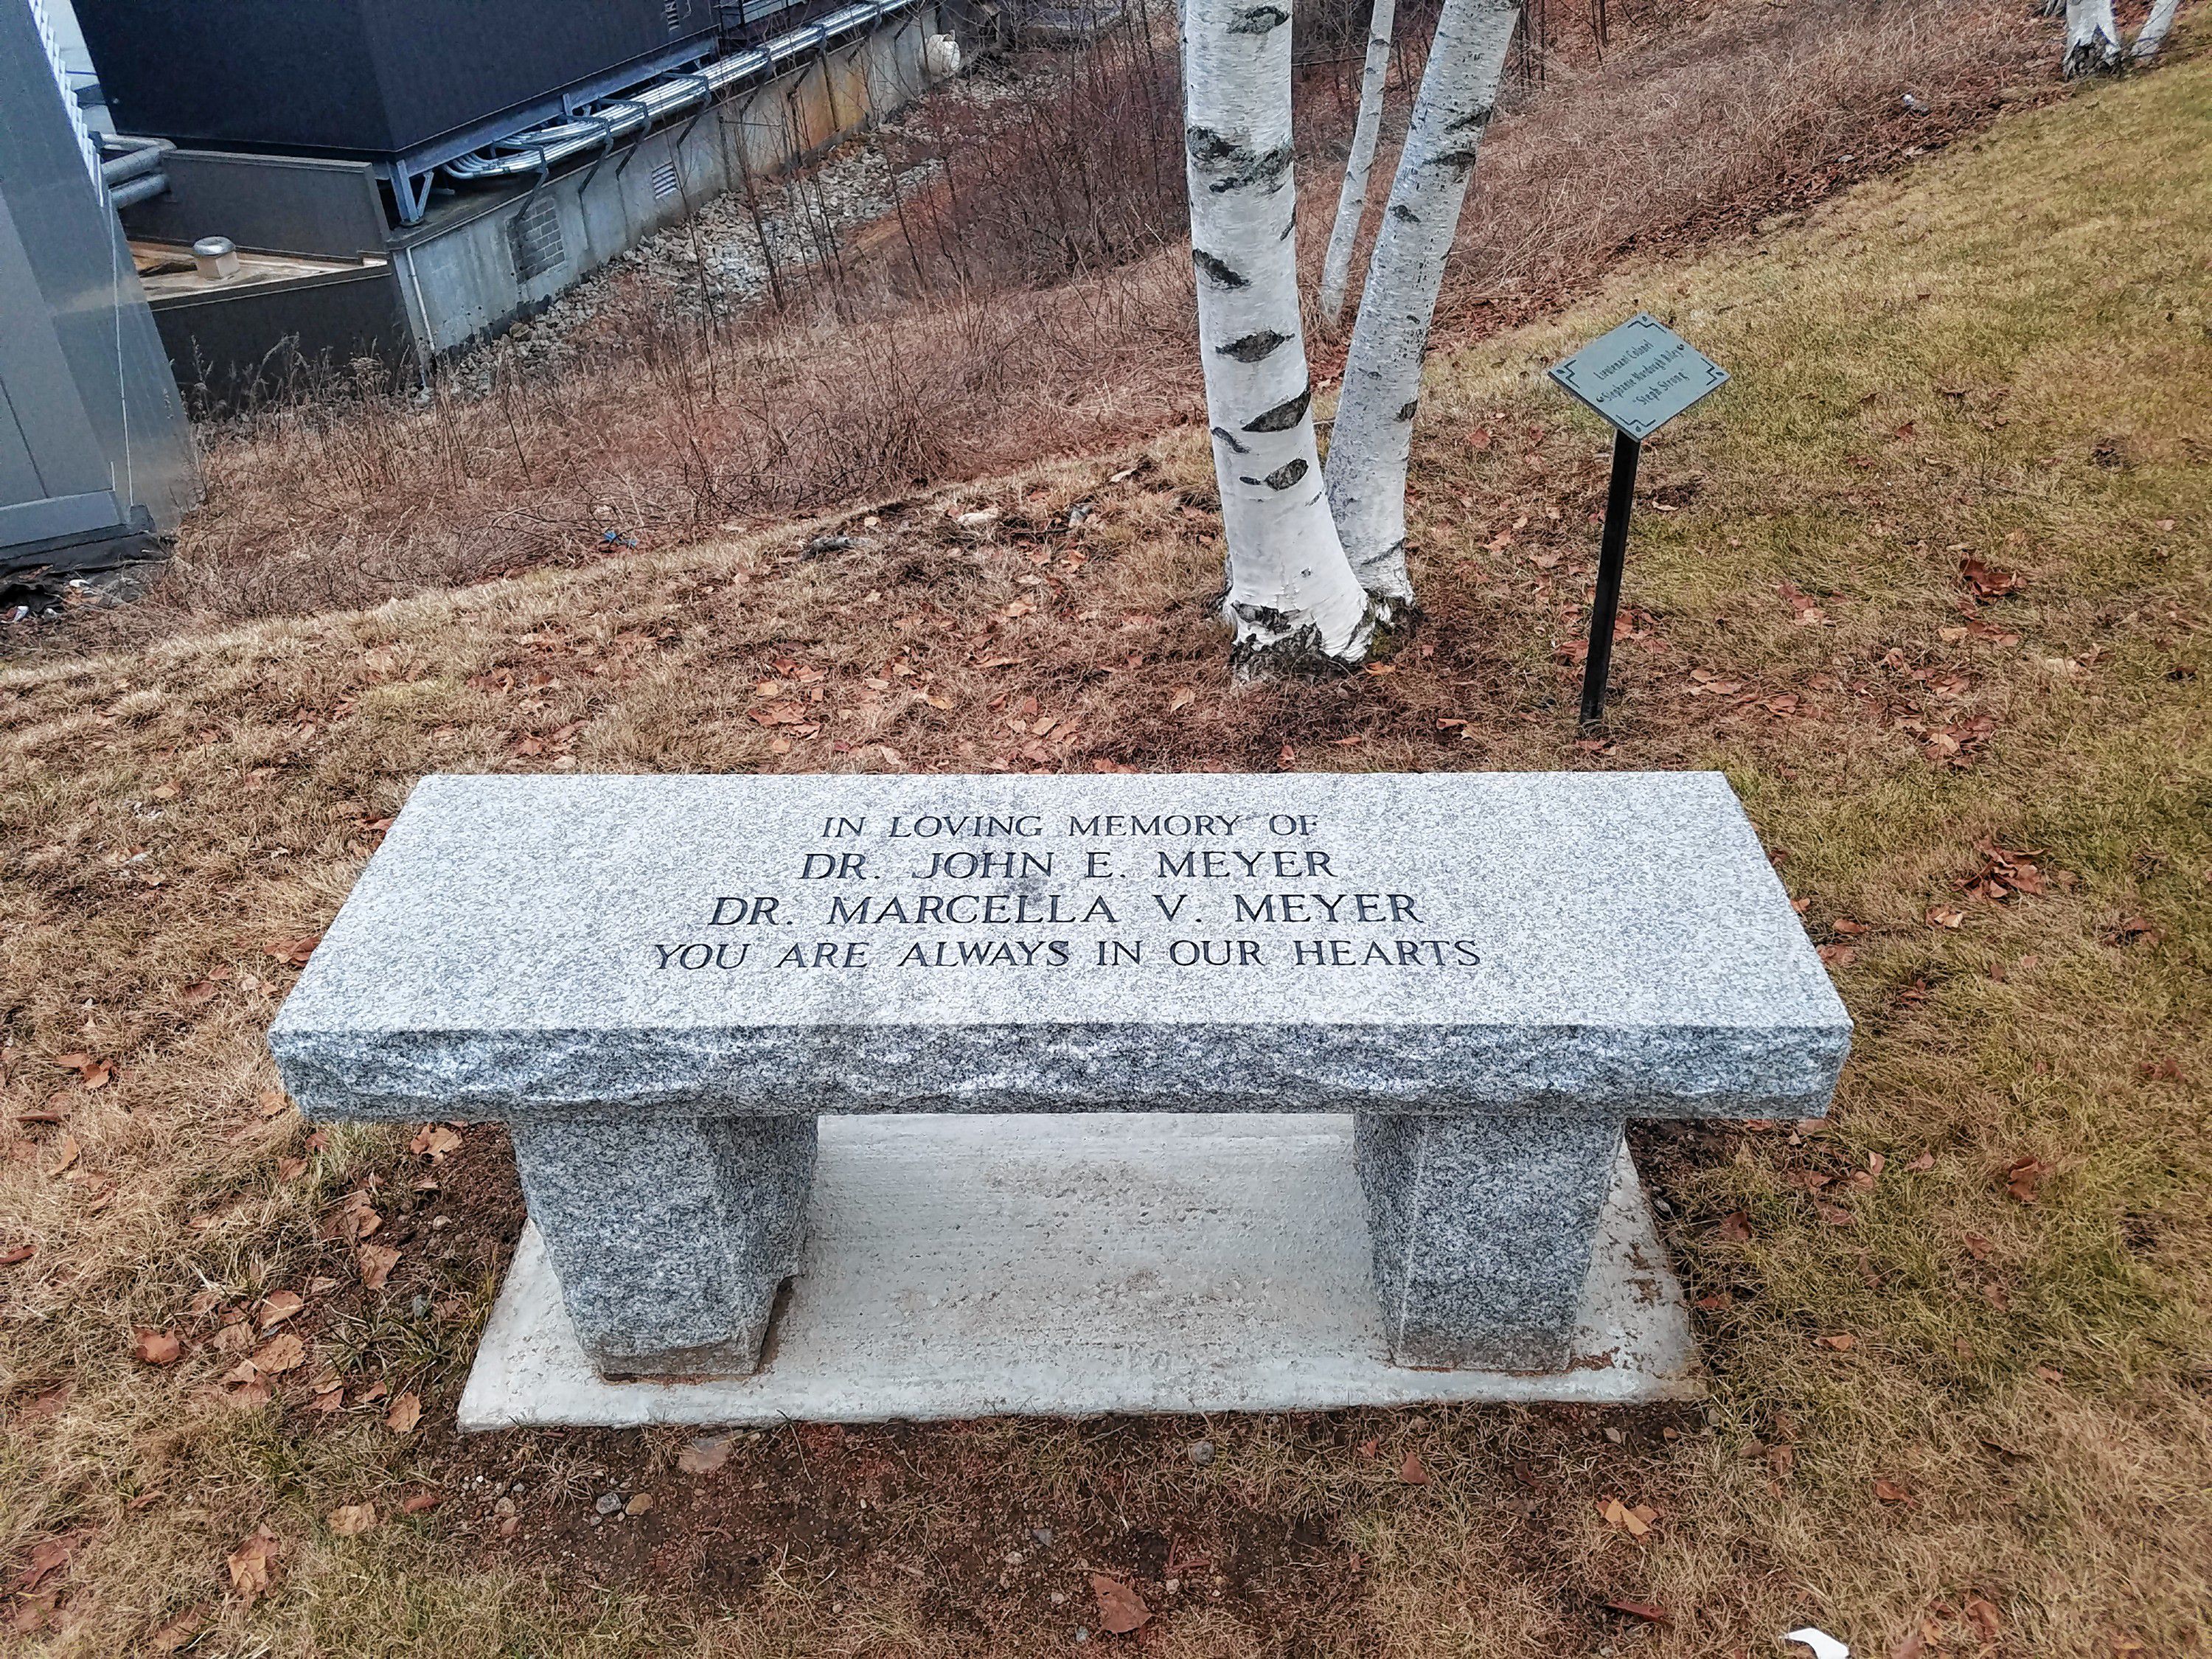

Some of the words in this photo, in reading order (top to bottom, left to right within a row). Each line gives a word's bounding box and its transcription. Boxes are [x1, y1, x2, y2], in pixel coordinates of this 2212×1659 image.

[1626, 339, 1655, 359] Colonel
[824, 815, 869, 838] IN
[889, 815, 1042, 838] LOVING
[1069, 815, 1239, 837] MEMORY
[1269, 814, 1318, 835] OF
[800, 852, 880, 881] DR.
[911, 850, 1053, 880] JOHN
[1085, 850, 1126, 879] E.
[1157, 849, 1337, 878] MEYER
[708, 895, 796, 927] DR.
[827, 894, 1120, 925] MARCELLA
[1153, 893, 1203, 922] V.
[1234, 892, 1423, 923] MEYER
[653, 942, 752, 970] YOU
[775, 942, 870, 969] ARE
[897, 941, 1069, 968] ALWAYS
[1096, 940, 1141, 967] IN
[1169, 939, 1265, 967] OUR
[1295, 939, 1481, 967] HEARTS
